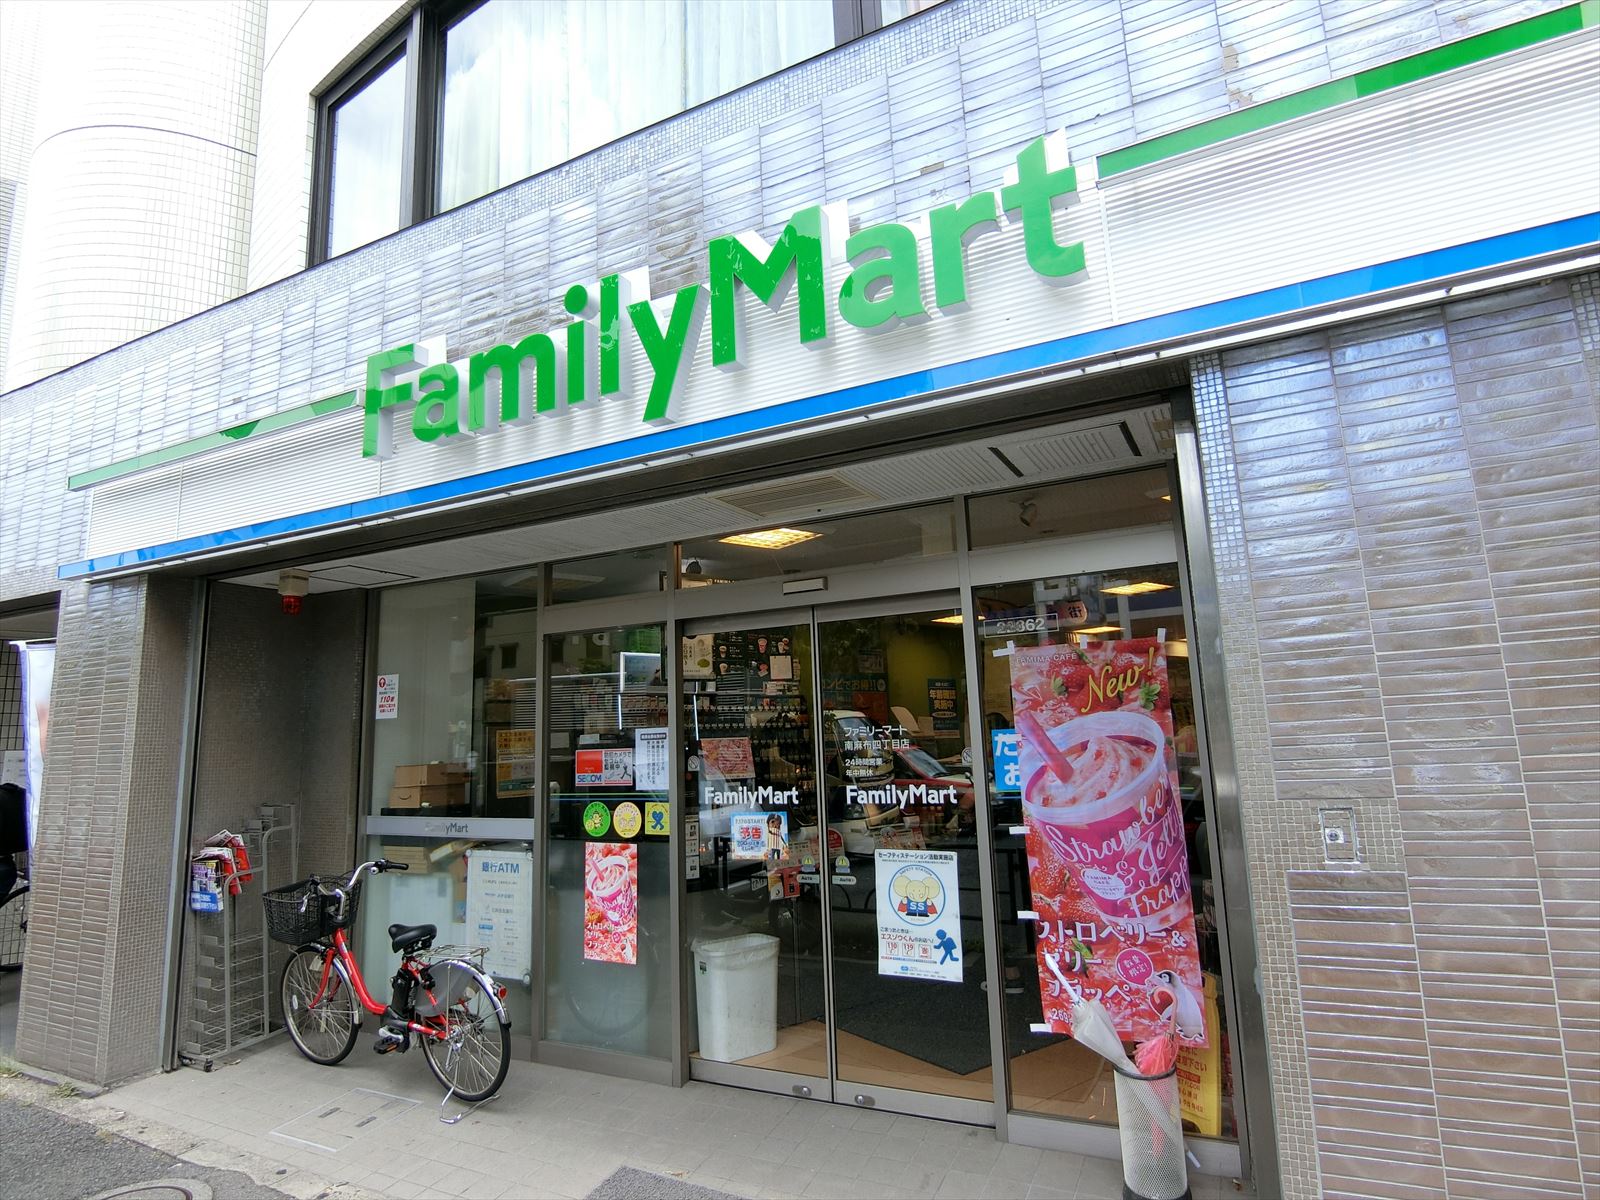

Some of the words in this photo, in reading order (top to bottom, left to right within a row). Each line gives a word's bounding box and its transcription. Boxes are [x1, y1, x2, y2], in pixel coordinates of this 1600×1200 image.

[362, 131, 1088, 460] FamilyMart
[1080, 646, 1155, 713] New!
[843, 724, 908, 737] ファミリーマート
[844, 739, 910, 751] 南麻布四丁目店
[845, 757, 883, 767] 24時間営業
[577, 774, 602, 783] SECOM
[845, 769, 874, 777] 年中無休
[704, 785, 800, 809] FamilyMart
[845, 784, 958, 810] FamilyMart
[481, 861, 520, 875] 銀行ATM
[909, 901, 925, 911] SS
